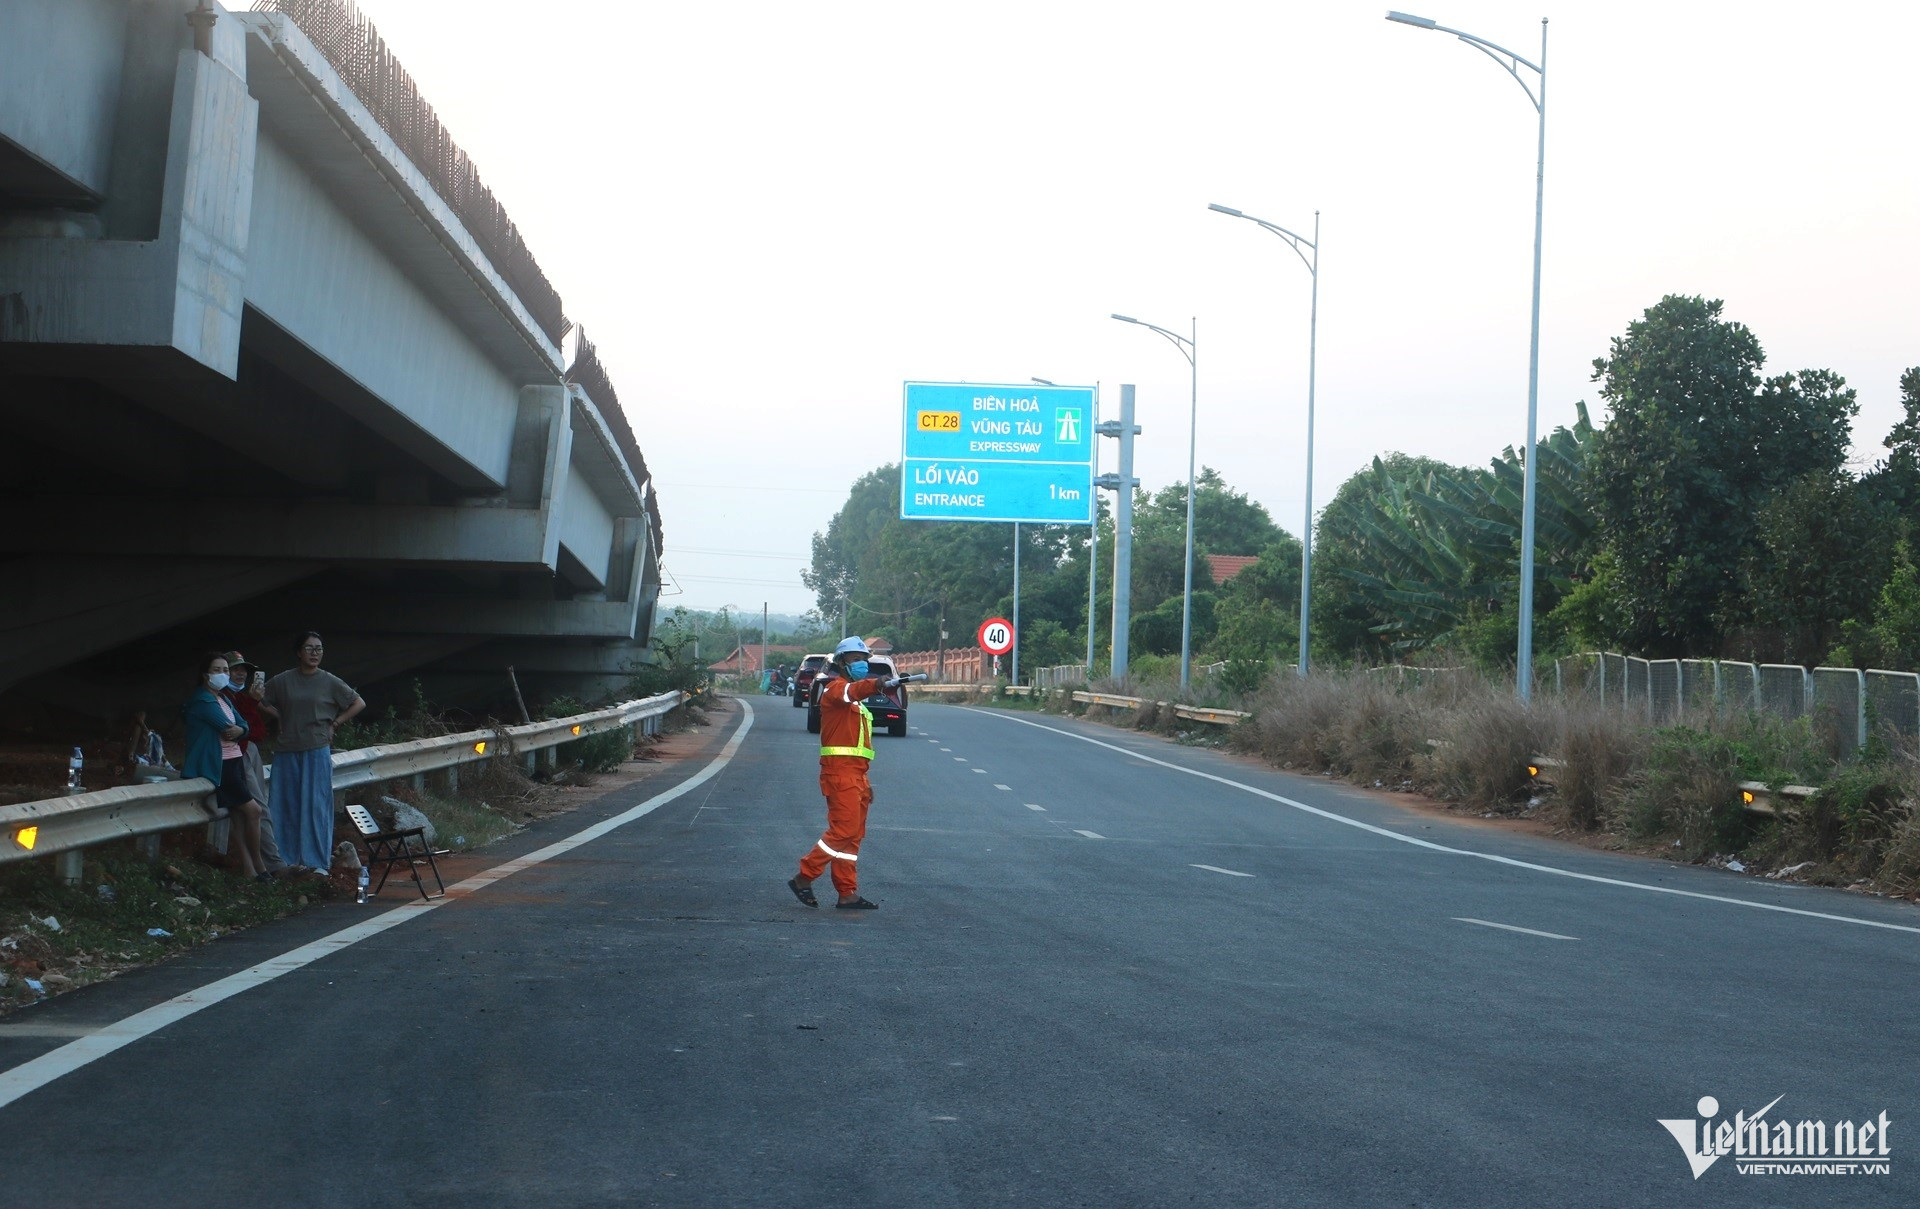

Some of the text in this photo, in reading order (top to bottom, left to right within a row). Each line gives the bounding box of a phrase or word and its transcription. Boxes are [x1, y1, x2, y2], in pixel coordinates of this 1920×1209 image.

[973, 395, 1006, 411] BIÊN
[922, 415, 958, 428] CT.28
[971, 418, 1042, 435] VŨNG TÀU
[970, 441, 1041, 453] EXPRESSWAY
[915, 463, 979, 485] LỐI VÀO
[915, 493, 985, 507] ENTRANCE
[1049, 484, 1080, 500] 1 km
[989, 628, 1005, 644] 40
